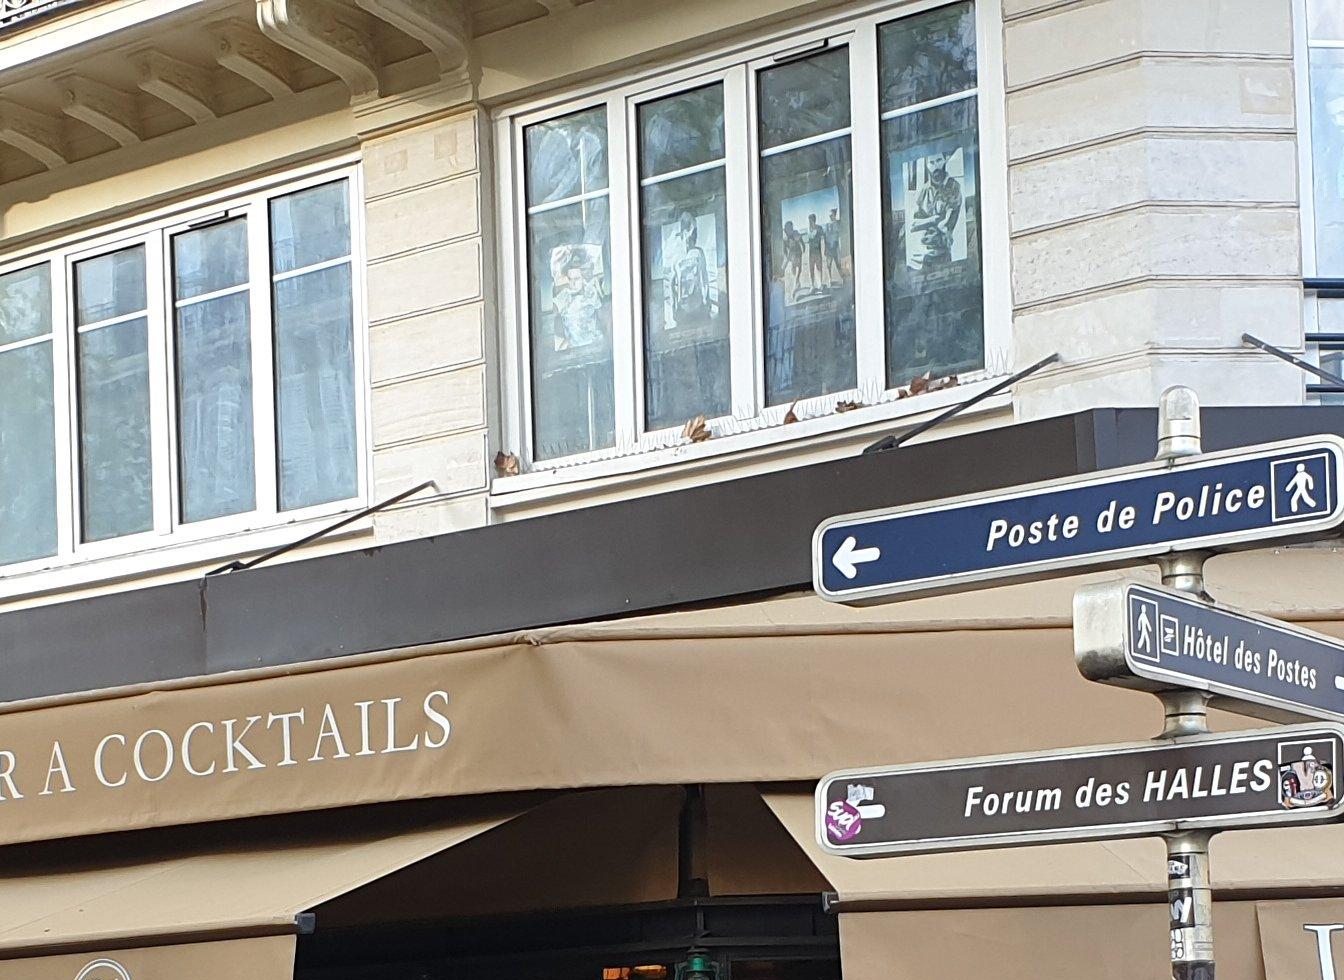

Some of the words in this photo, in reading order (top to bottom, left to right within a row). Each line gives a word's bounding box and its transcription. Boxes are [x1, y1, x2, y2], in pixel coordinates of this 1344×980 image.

[985, 514, 1080, 552] Poste
[1096, 501, 1138, 534] de
[1152, 481, 1266, 526] Police
[1182, 623, 1230, 667] Hôtel
[1233, 637, 1262, 675] des
[1266, 652, 1318, 691] Postes
[38, 741, 77, 797] A
[93, 689, 453, 788] COCKTAILS
[963, 784, 1063, 820] Forum
[1076, 779, 1131, 811] des
[1142, 758, 1275, 804] HALLES
